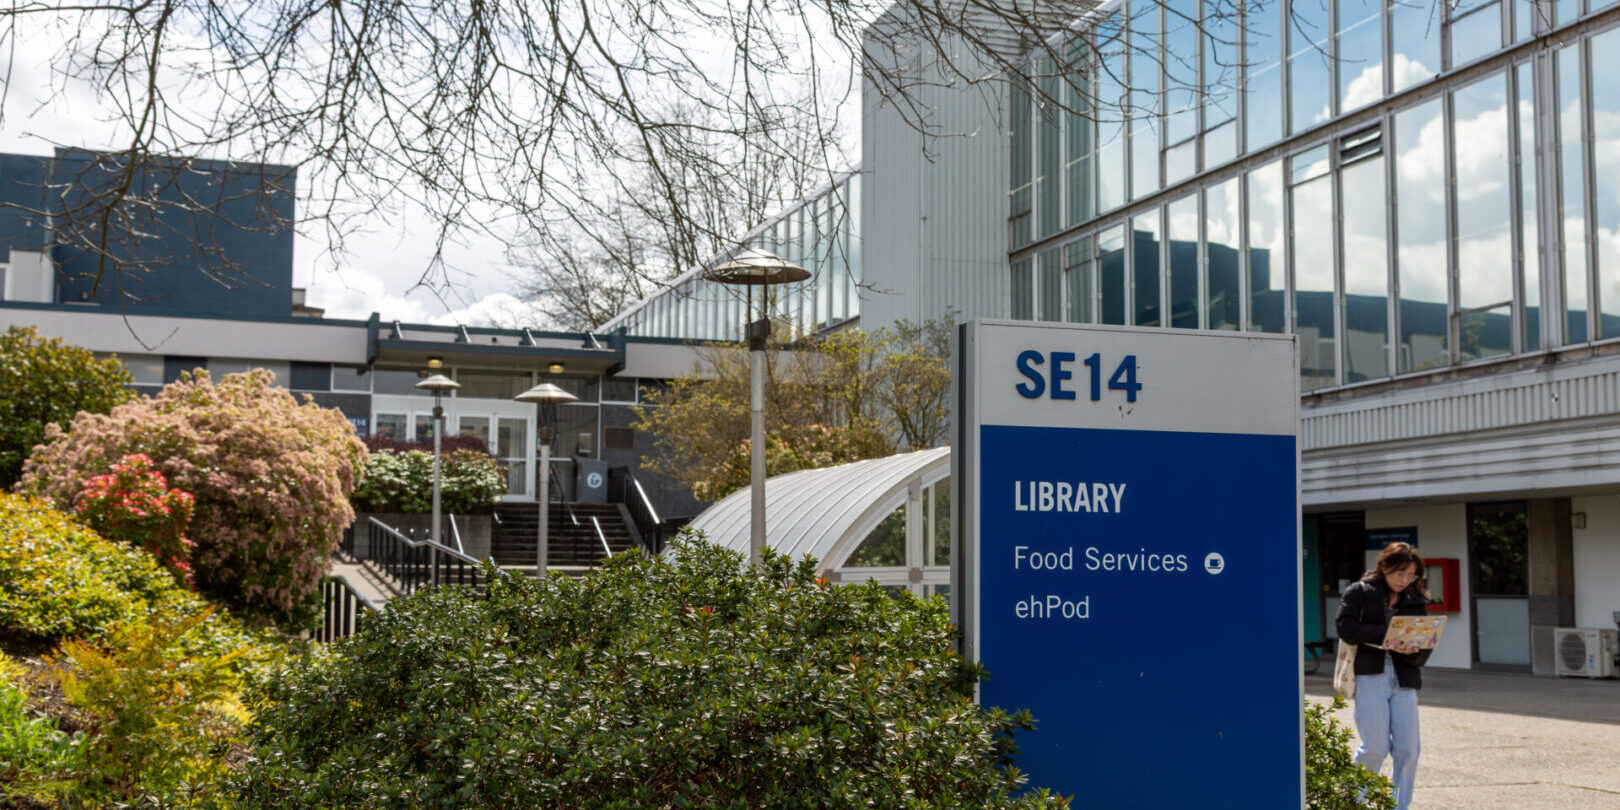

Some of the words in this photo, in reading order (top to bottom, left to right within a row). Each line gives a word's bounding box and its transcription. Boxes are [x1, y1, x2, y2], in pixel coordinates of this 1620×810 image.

[1016, 350, 1142, 402] SE14
[1015, 481, 1127, 513] LIBRARY
[1015, 546, 1073, 570] Food
[1085, 547, 1188, 571] Services
[1015, 595, 1090, 618] ehPod
